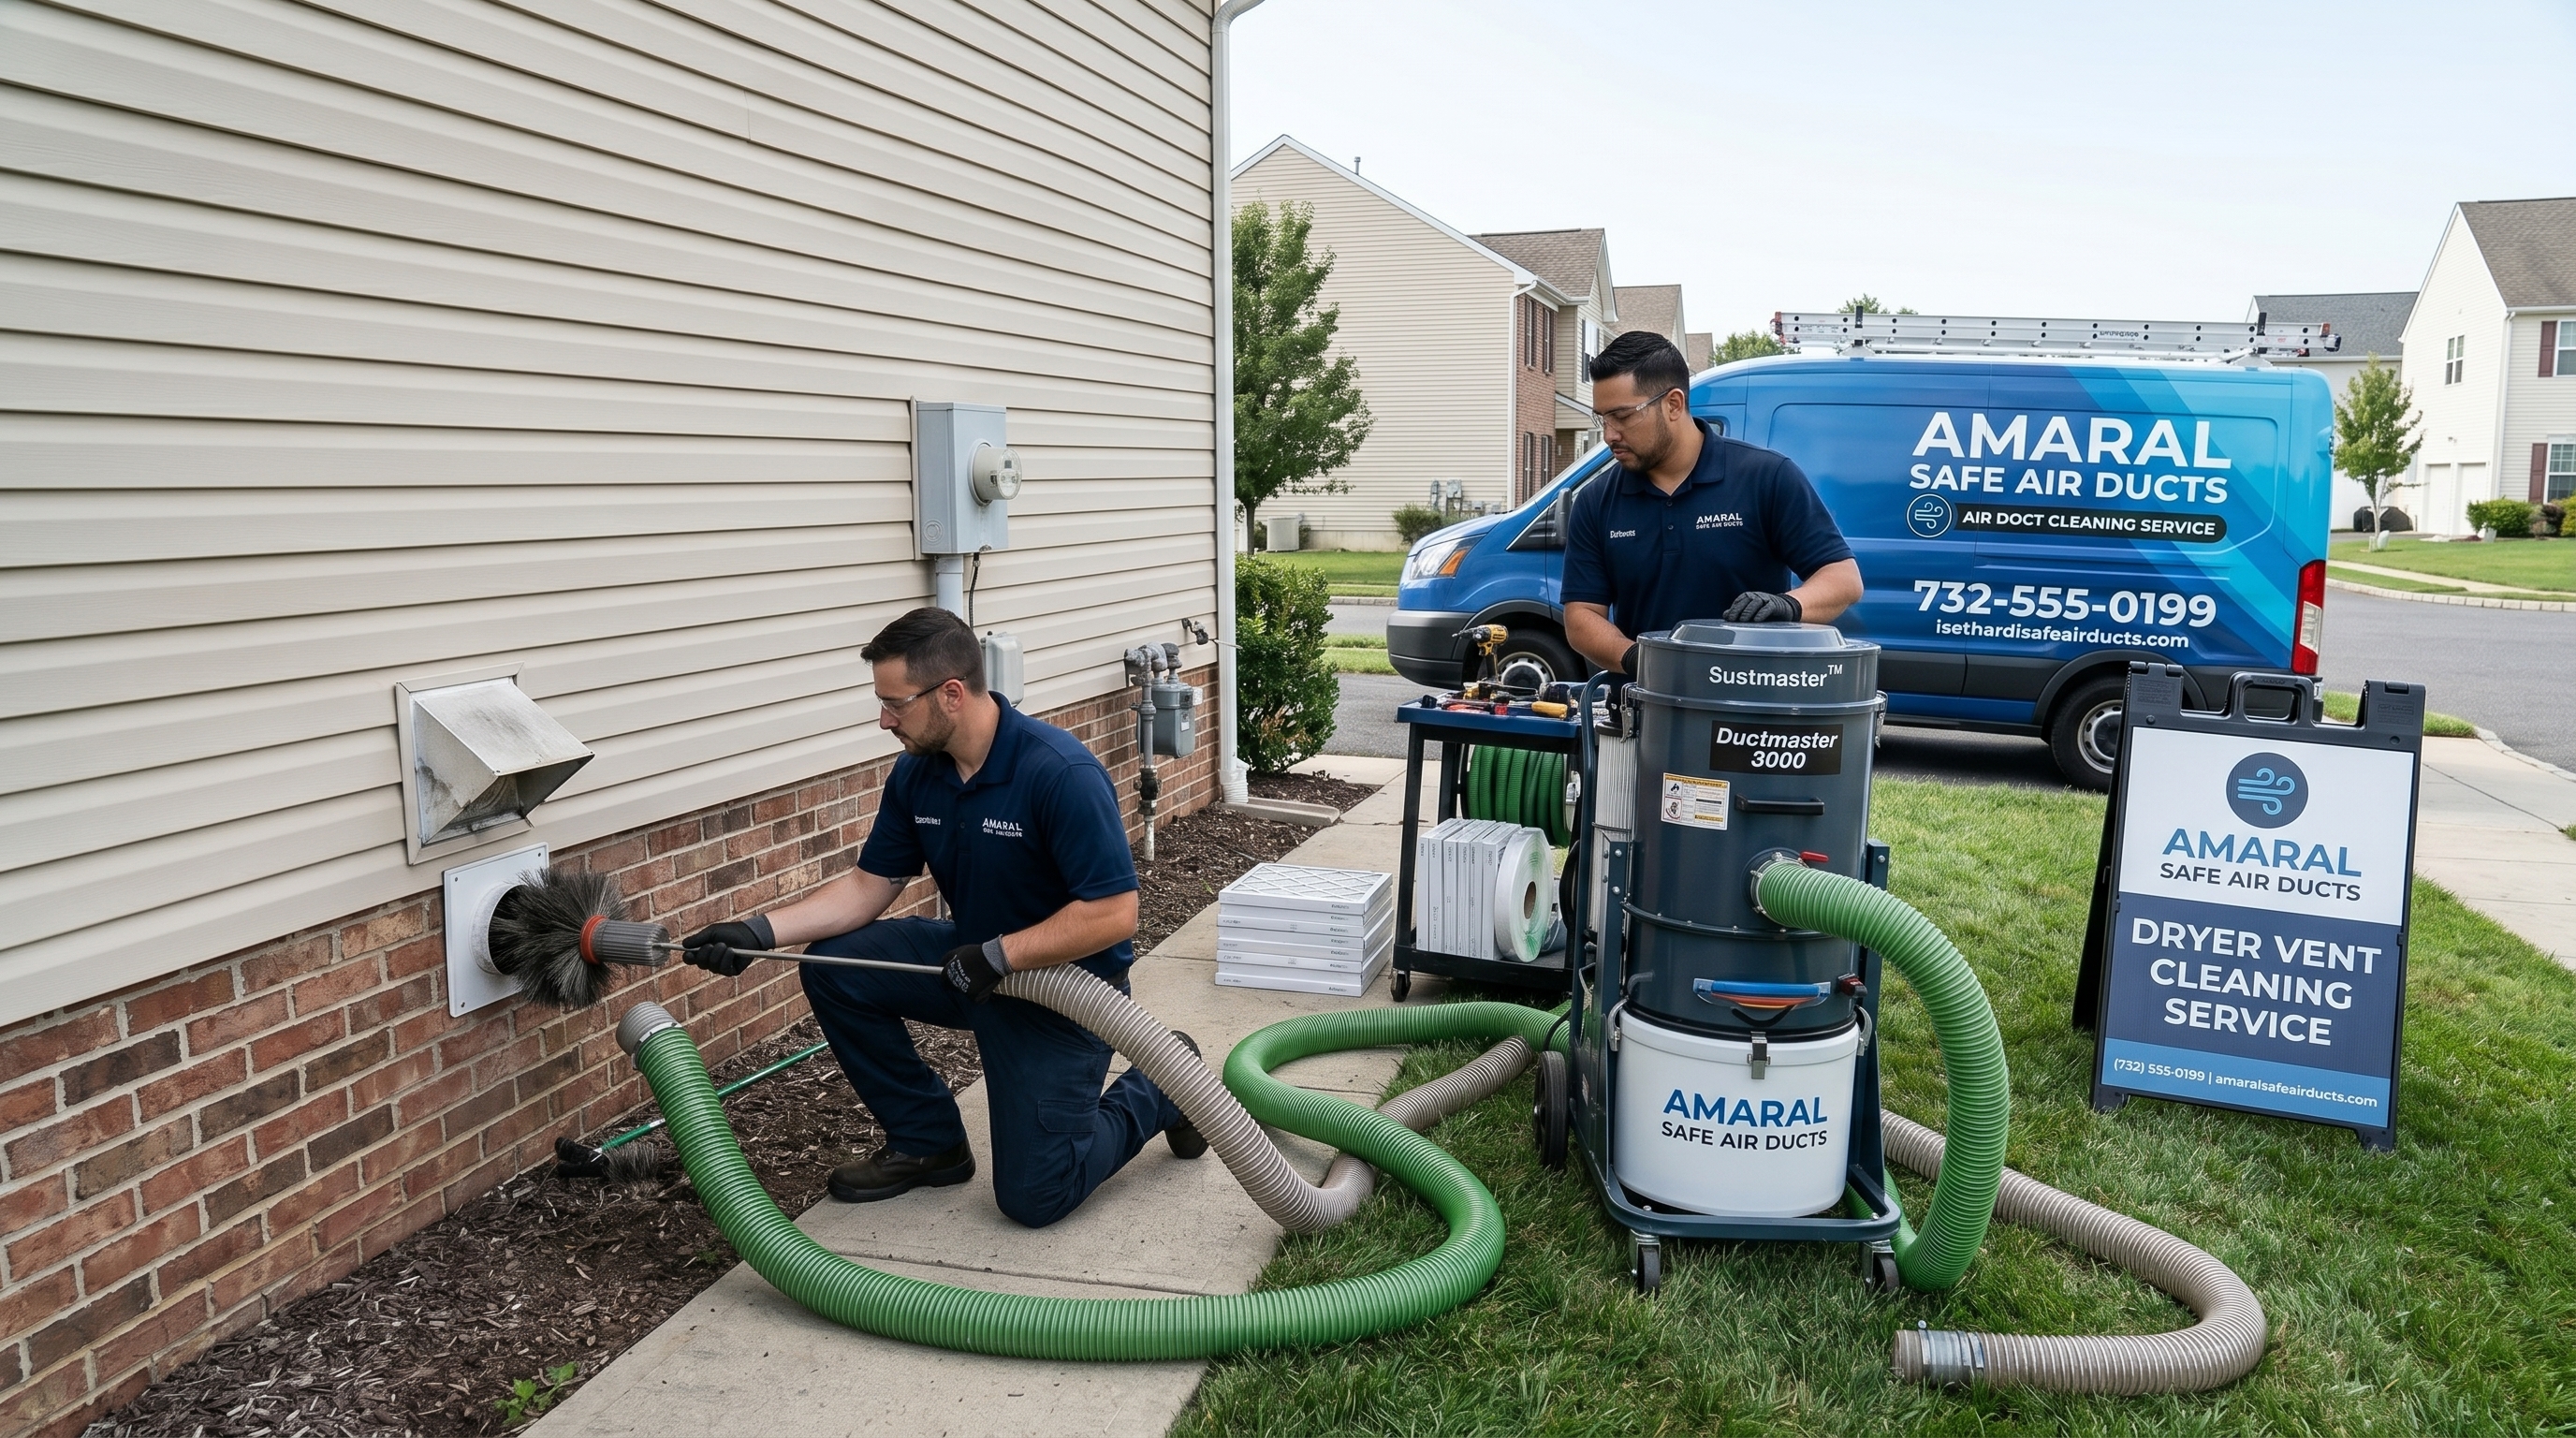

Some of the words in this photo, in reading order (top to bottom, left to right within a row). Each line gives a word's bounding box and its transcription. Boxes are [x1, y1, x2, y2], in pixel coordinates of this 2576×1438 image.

[1911, 411, 2232, 469] AMARAL
[1909, 463, 2005, 493] SAFE
[2015, 469, 2083, 497] AIR
[2095, 472, 2229, 505] DUCTS
[1696, 512, 1743, 524] AMARAL
[1962, 510, 1992, 525] AIR
[1996, 512, 2045, 528] DOCT
[2048, 515, 2136, 532] CLEANING
[2140, 519, 2216, 536] SERVICE
[1913, 579, 2217, 628] 732-555-0199
[1936, 619, 2189, 649] isethardisafeairducts.com
[1716, 726, 1838, 749] Ductmaster
[1750, 751, 1807, 770] 3000
[982, 817, 1023, 831] AMARAL
[2162, 828, 2362, 877] AMARAL
[2159, 862, 2221, 886] SAFE
[2228, 871, 2269, 890] AIR
[2277, 875, 2361, 902] DUCTS
[2131, 917, 2262, 960] DRYER
[2274, 935, 2382, 975] VENT
[2150, 958, 2352, 1010] CLEANING
[2163, 998, 2332, 1047] SERVICE
[2114, 1058, 2144, 1075] (732)
[2215, 1074, 2378, 1108] amaralsafeairducts.com
[1662, 1089, 1828, 1128] AMARAL
[1661, 1121, 1714, 1146] SAFE
[1720, 1133, 1758, 1151] AIR
[1765, 1130, 1827, 1151] DUCTS
